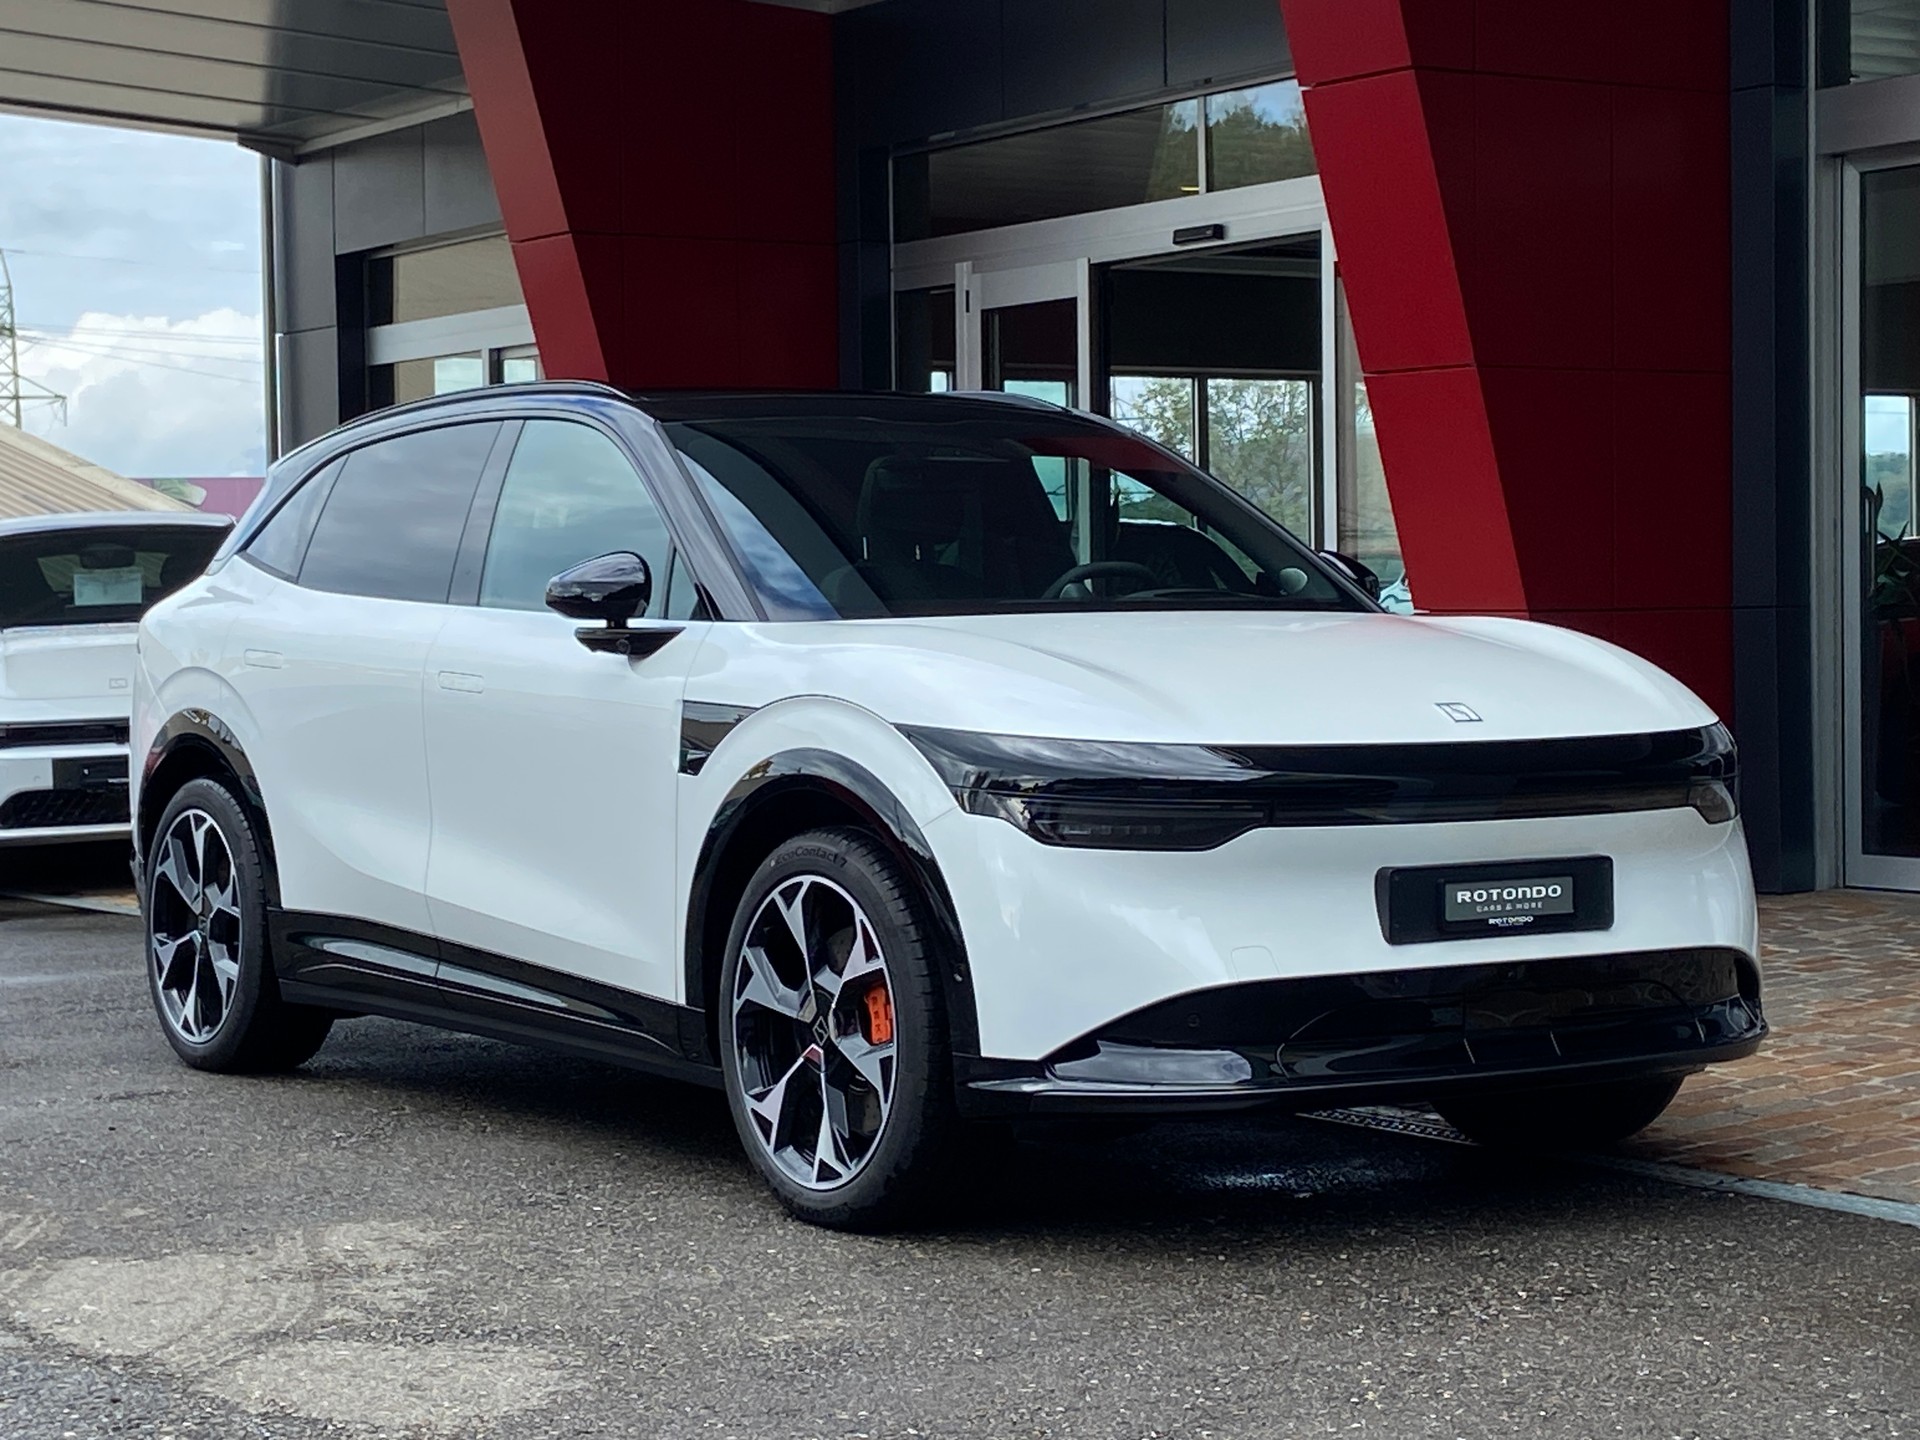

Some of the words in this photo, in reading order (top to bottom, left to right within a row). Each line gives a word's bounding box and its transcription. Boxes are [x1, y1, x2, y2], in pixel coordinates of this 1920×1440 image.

[1457, 885, 1562, 903] ROTONDO
[1476, 904, 1502, 913] CARS
[1515, 901, 1543, 910] MORE
